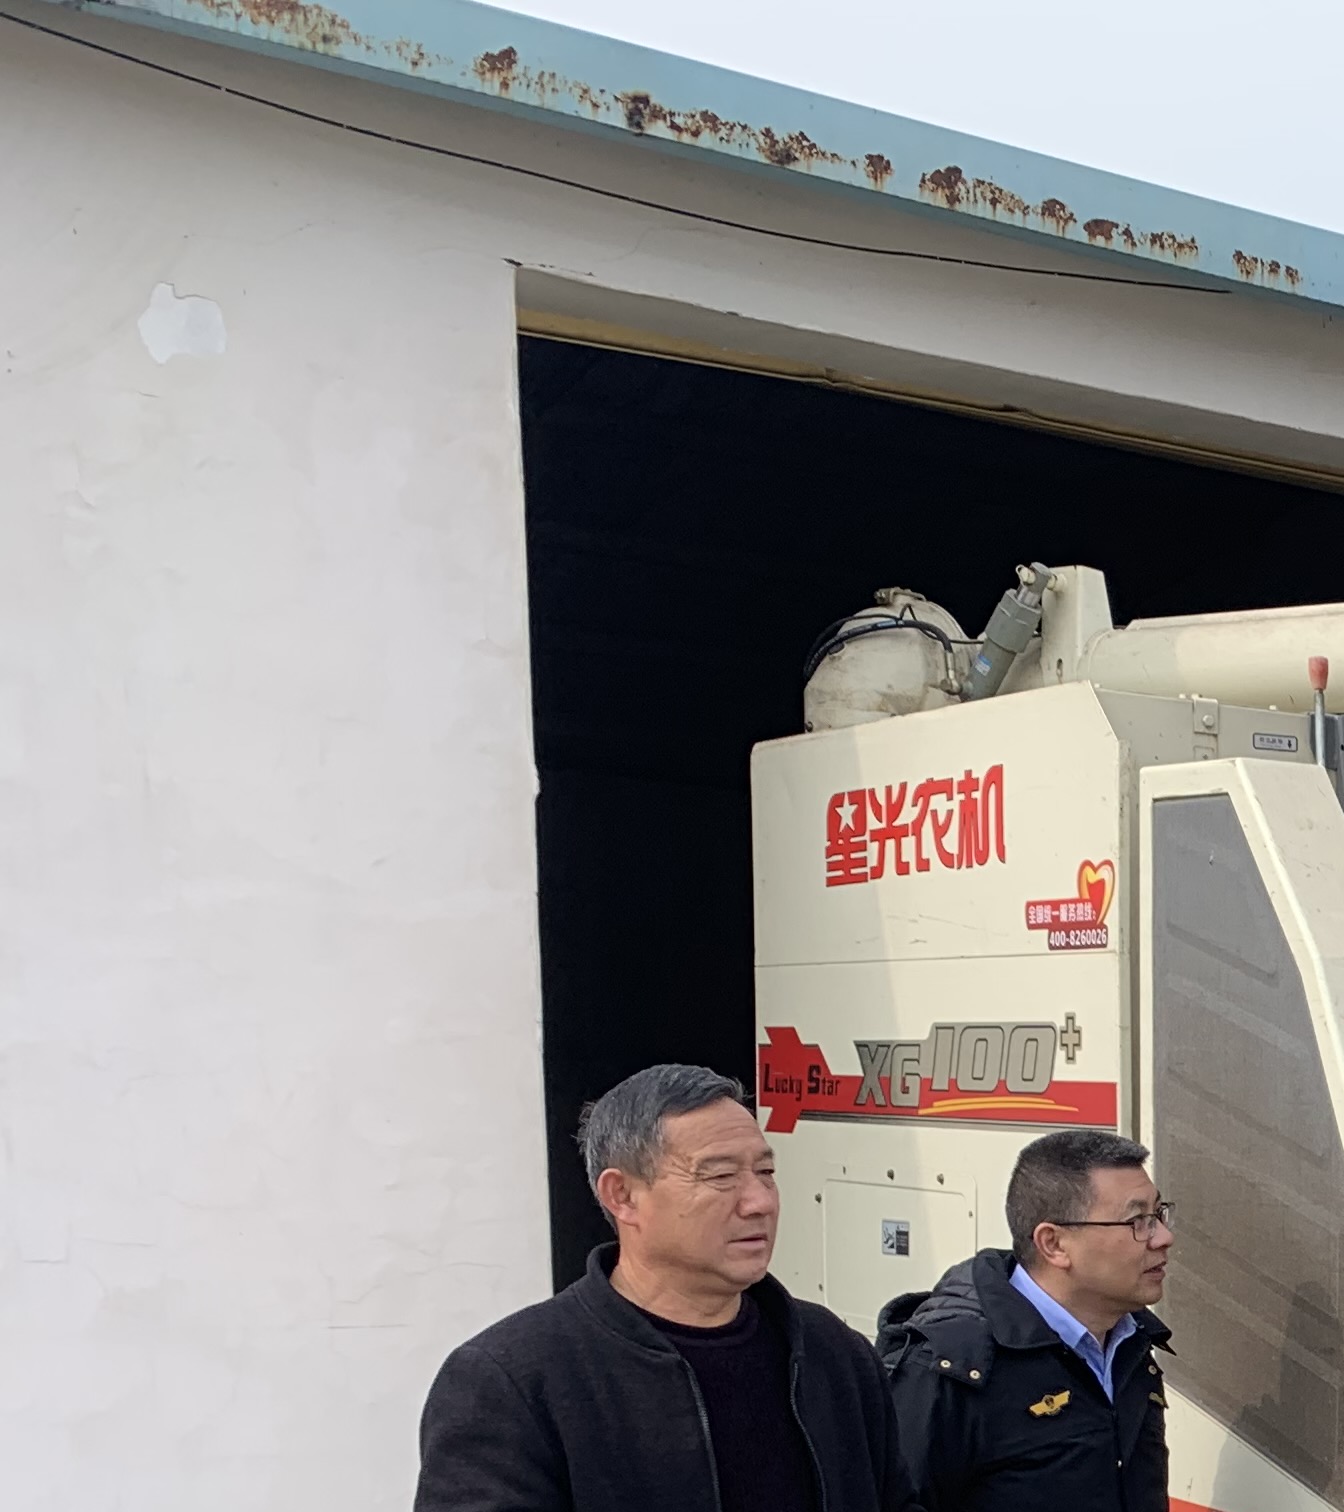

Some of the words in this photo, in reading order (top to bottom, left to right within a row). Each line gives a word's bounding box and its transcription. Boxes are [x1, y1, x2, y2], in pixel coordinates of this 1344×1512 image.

[825, 764, 1006, 887] 星光农机
[1049, 928, 1107, 946] 400-8260026
[763, 1063, 803, 1102] Lucky
[807, 1064, 842, 1098] Star
